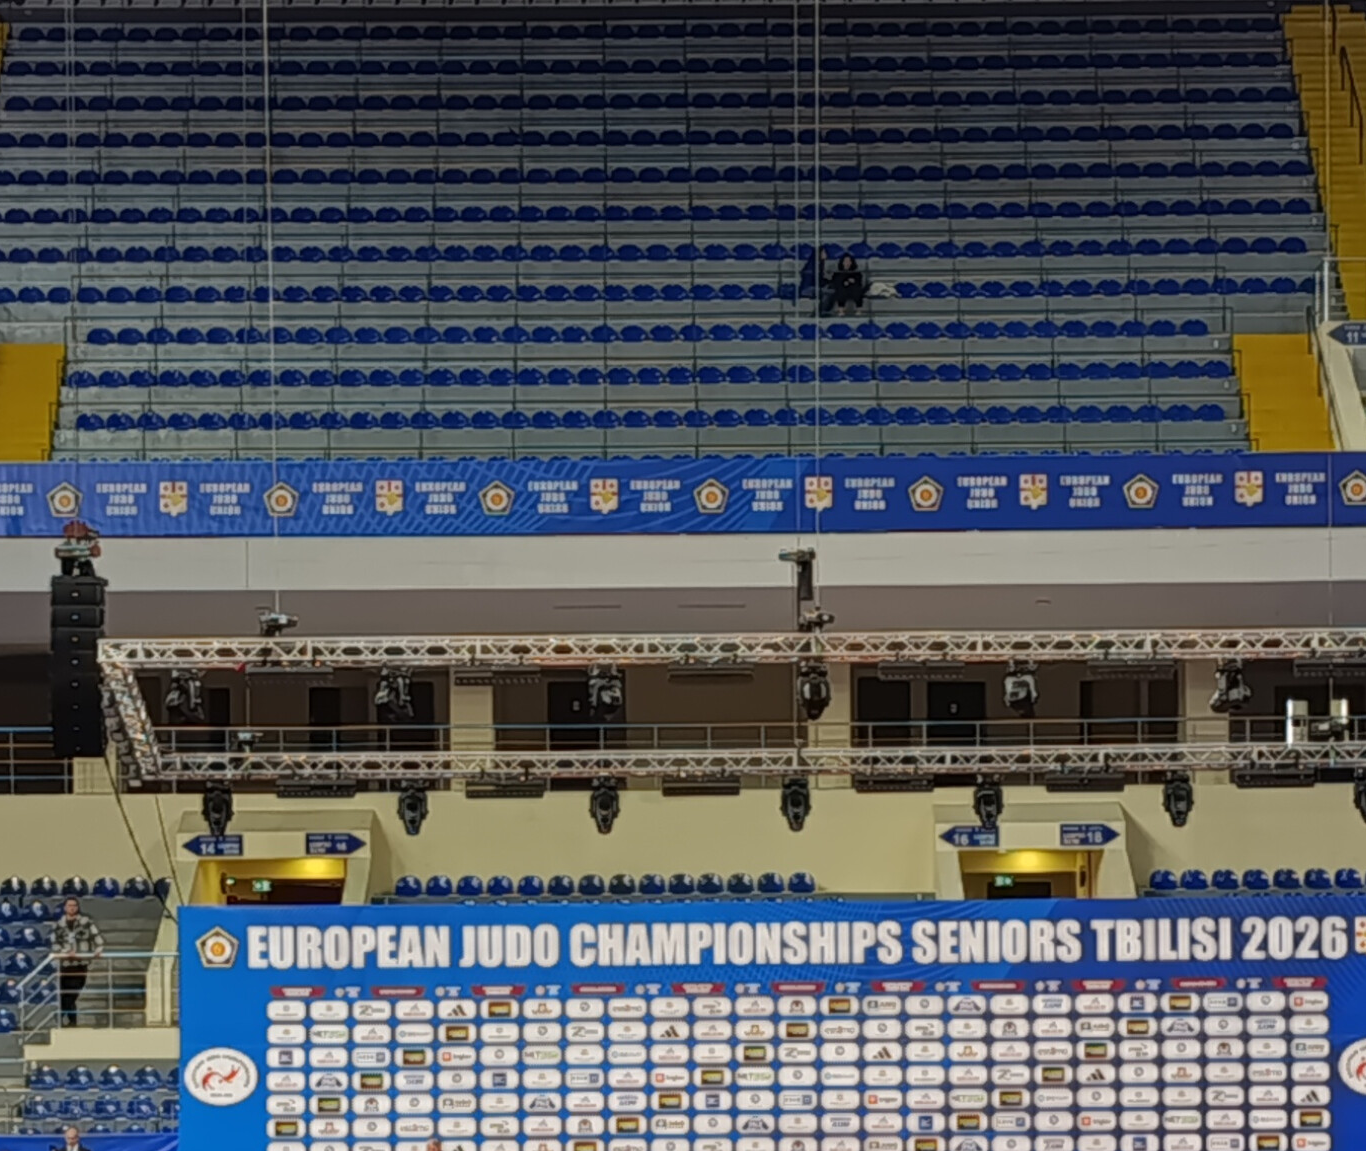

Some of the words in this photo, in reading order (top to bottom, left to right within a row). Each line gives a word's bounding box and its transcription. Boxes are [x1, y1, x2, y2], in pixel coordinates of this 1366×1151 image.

[246, 923, 451, 969] EUROPEAN
[459, 922, 561, 968] JUDO
[569, 919, 903, 966] CHAMPIONSHIPS
[911, 917, 1082, 963] SENIORS
[1090, 916, 1232, 961] TBILISI
[1241, 915, 1348, 960] 2026
